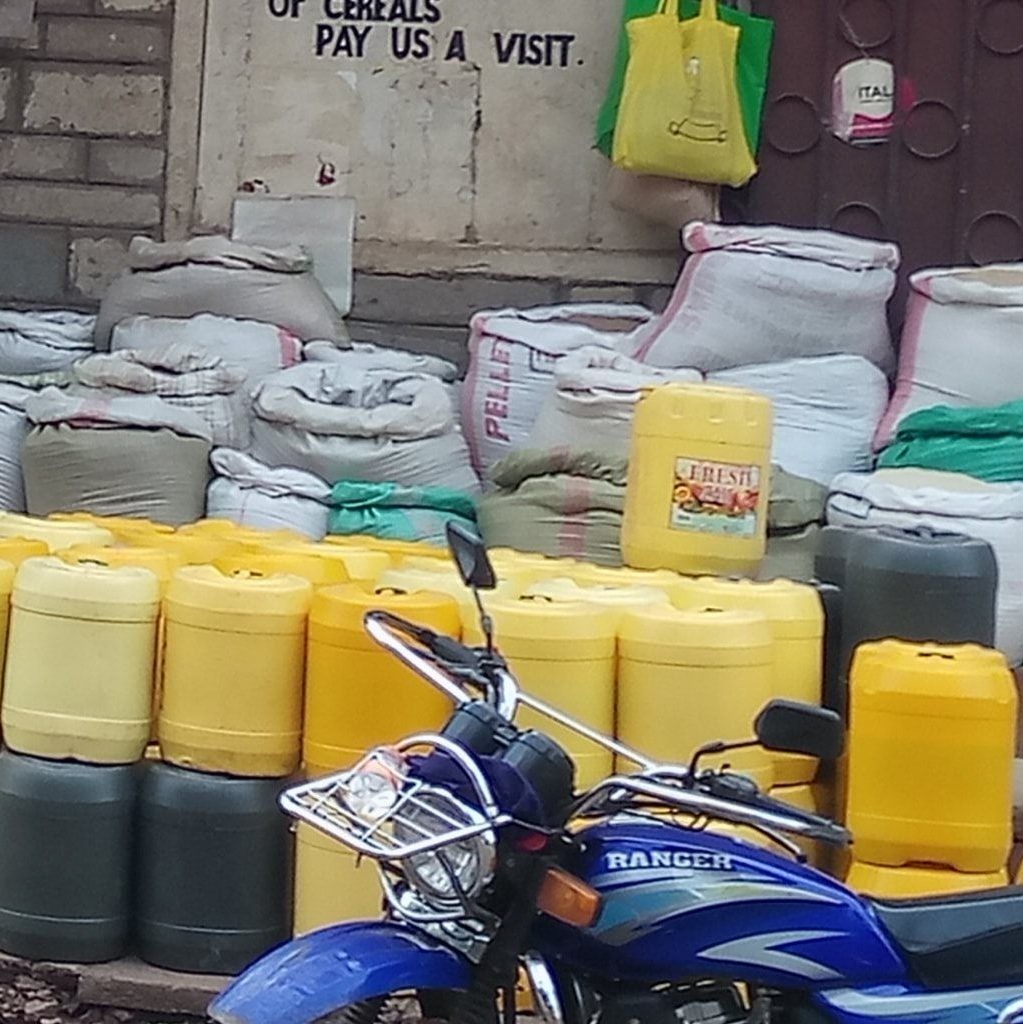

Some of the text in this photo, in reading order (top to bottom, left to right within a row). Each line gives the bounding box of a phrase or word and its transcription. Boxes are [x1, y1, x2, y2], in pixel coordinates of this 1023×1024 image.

[315, 24, 373, 58] PAY
[391, 27, 429, 60] US
[444, 31, 466, 62] A
[483, 336, 510, 443] PELLE
[607, 850, 733, 870] RANGER
